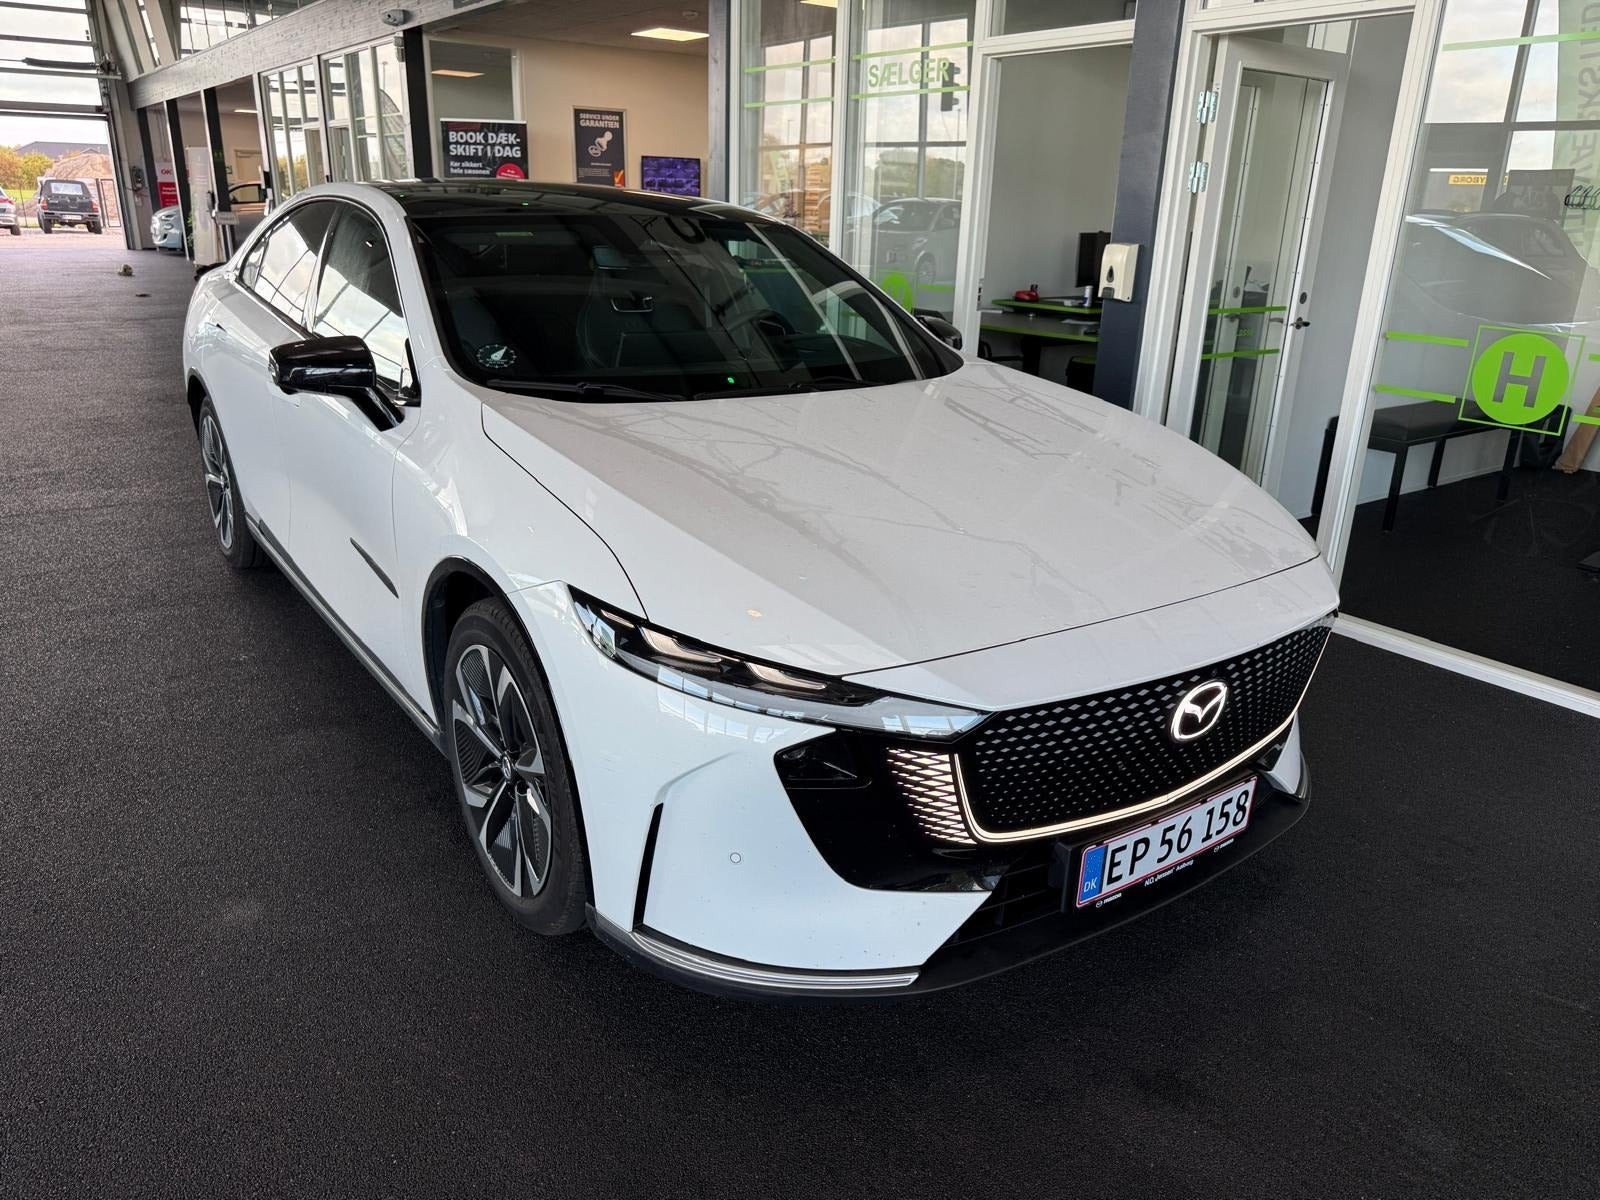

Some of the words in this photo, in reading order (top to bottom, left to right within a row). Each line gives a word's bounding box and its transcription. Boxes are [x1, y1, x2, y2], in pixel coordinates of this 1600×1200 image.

[868, 58, 950, 87] SÆLGER
[579, 120, 620, 129] GARANTIEN
[449, 131, 485, 144] BOOK
[488, 132, 520, 145] DÆK-
[449, 145, 484, 157] SKIFT
[487, 146, 491, 157] I
[494, 146, 521, 158] DAG
[1491, 350, 1547, 408] H
[1106, 836, 1150, 886] EP
[1156, 815, 1193, 864] 56
[1201, 789, 1250, 843] 158
[1083, 876, 1098, 893] DK
